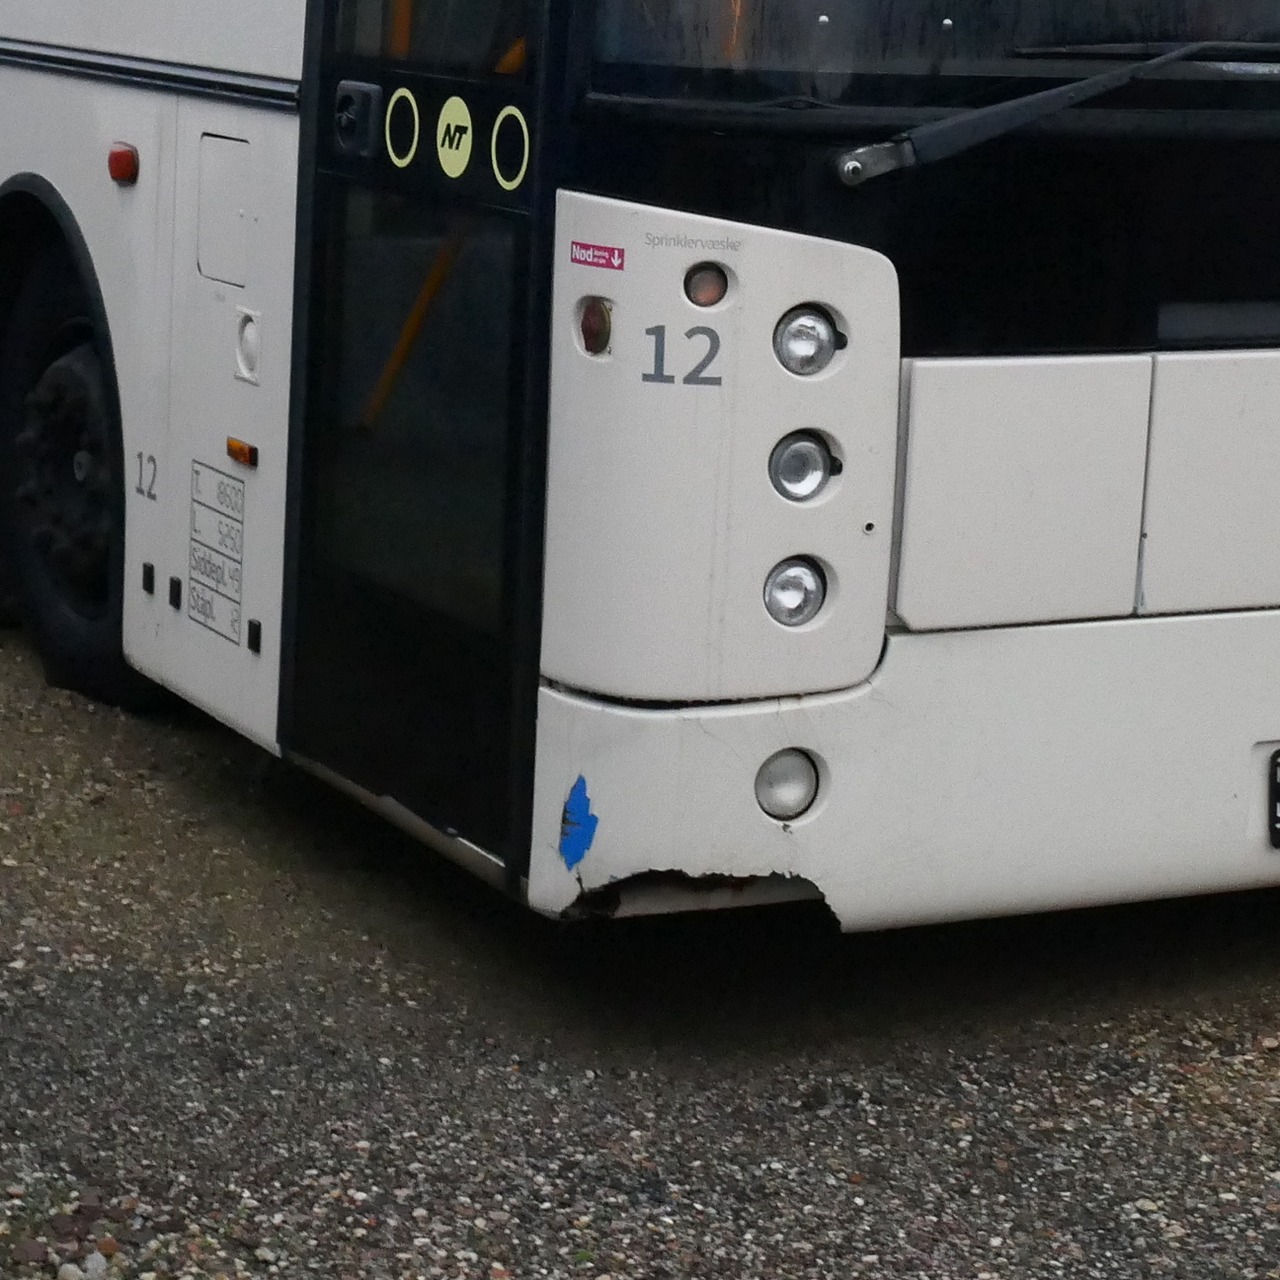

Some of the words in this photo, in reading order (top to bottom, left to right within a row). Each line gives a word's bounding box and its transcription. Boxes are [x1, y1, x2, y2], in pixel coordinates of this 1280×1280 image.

[440, 123, 468, 150] NT
[644, 232, 742, 251] Sprinklervæske
[641, 324, 723, 387] 12
[136, 451, 157, 501] 12
